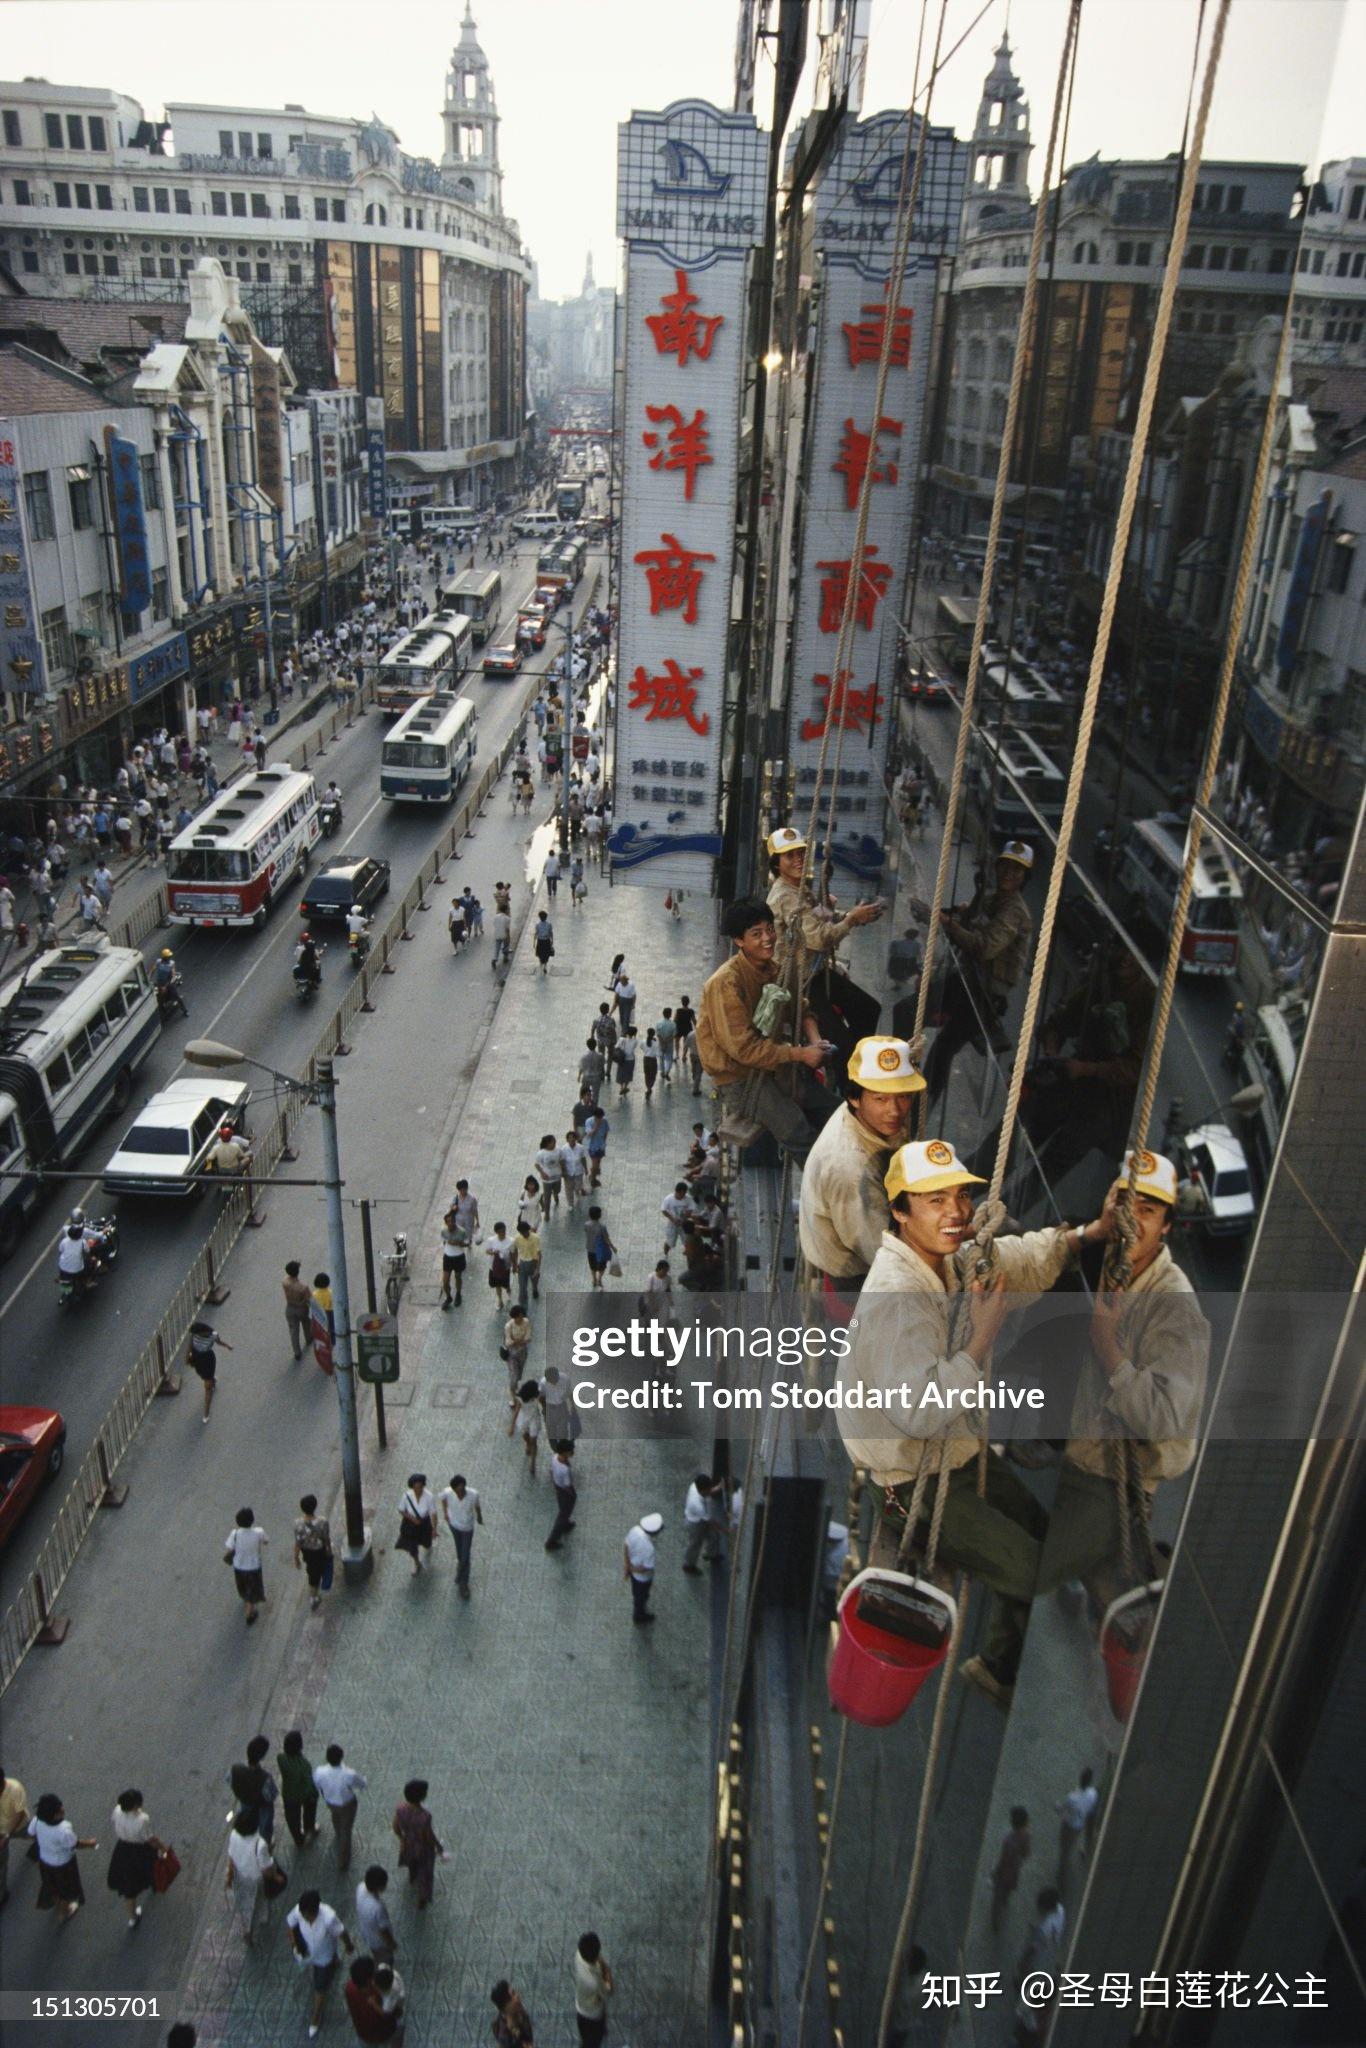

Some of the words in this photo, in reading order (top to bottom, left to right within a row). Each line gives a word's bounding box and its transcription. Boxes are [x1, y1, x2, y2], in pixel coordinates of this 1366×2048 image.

[626, 207, 674, 229] NAN
[690, 211, 756, 235] YANG
[628, 269, 723, 736] 南洋商城
